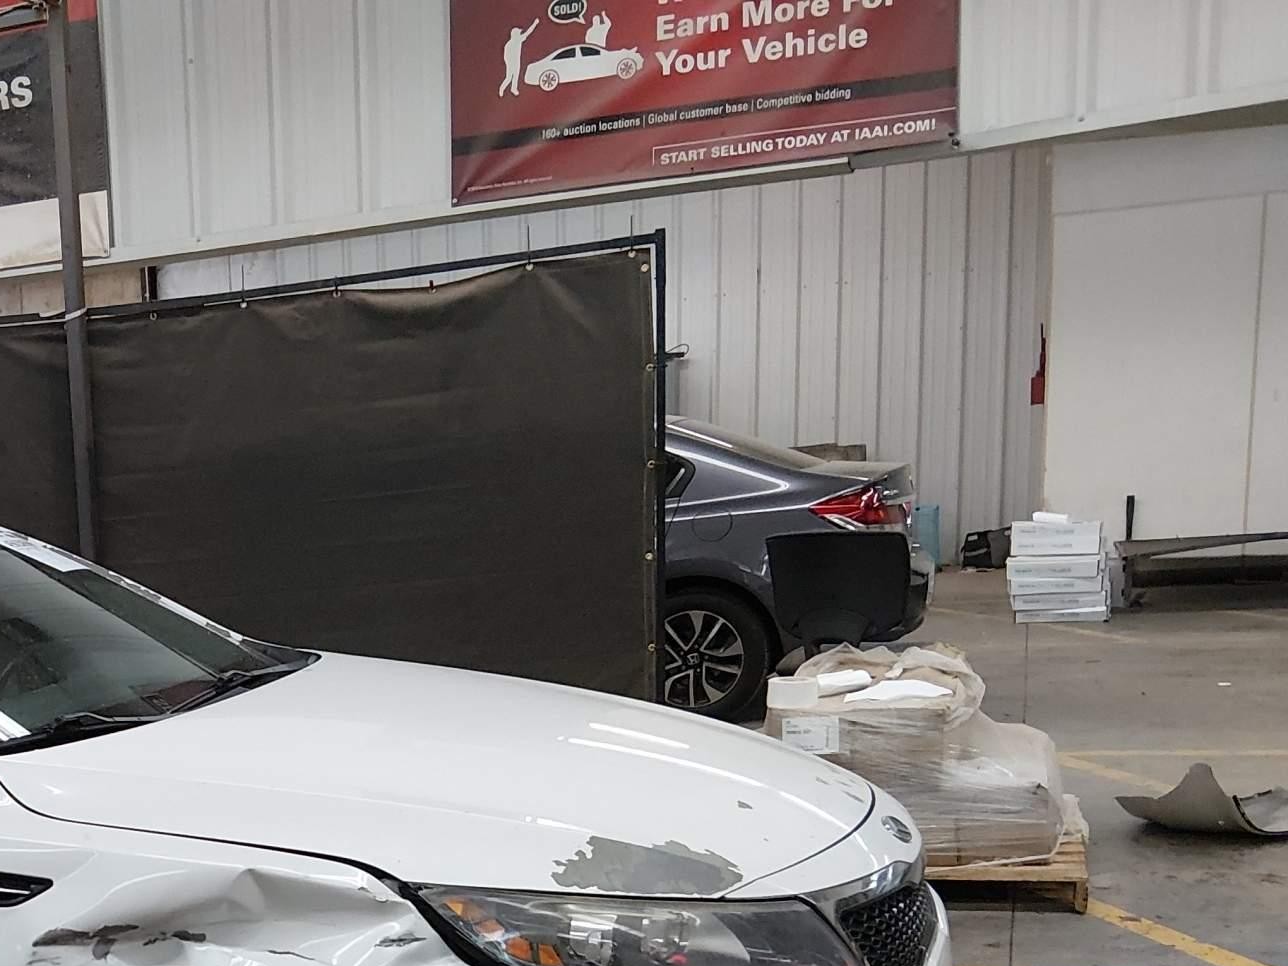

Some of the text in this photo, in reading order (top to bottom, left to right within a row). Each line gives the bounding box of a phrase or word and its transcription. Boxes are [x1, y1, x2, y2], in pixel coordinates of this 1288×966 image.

[554, 2, 582, 16] SOLD!
[656, 11, 729, 41] Earn
[742, 0, 830, 28] More
[655, 24, 868, 76] Your Vehicle
[563, 123, 597, 136] auction
[599, 117, 641, 132] locations
[648, 110, 677, 125] Global
[679, 104, 723, 120] customer
[726, 102, 748, 114] base
[756, 93, 812, 111] Competitive
[815, 88, 851, 102] bidding
[660, 119, 937, 165] START SELLING TODAY AT IAAI.COM!
